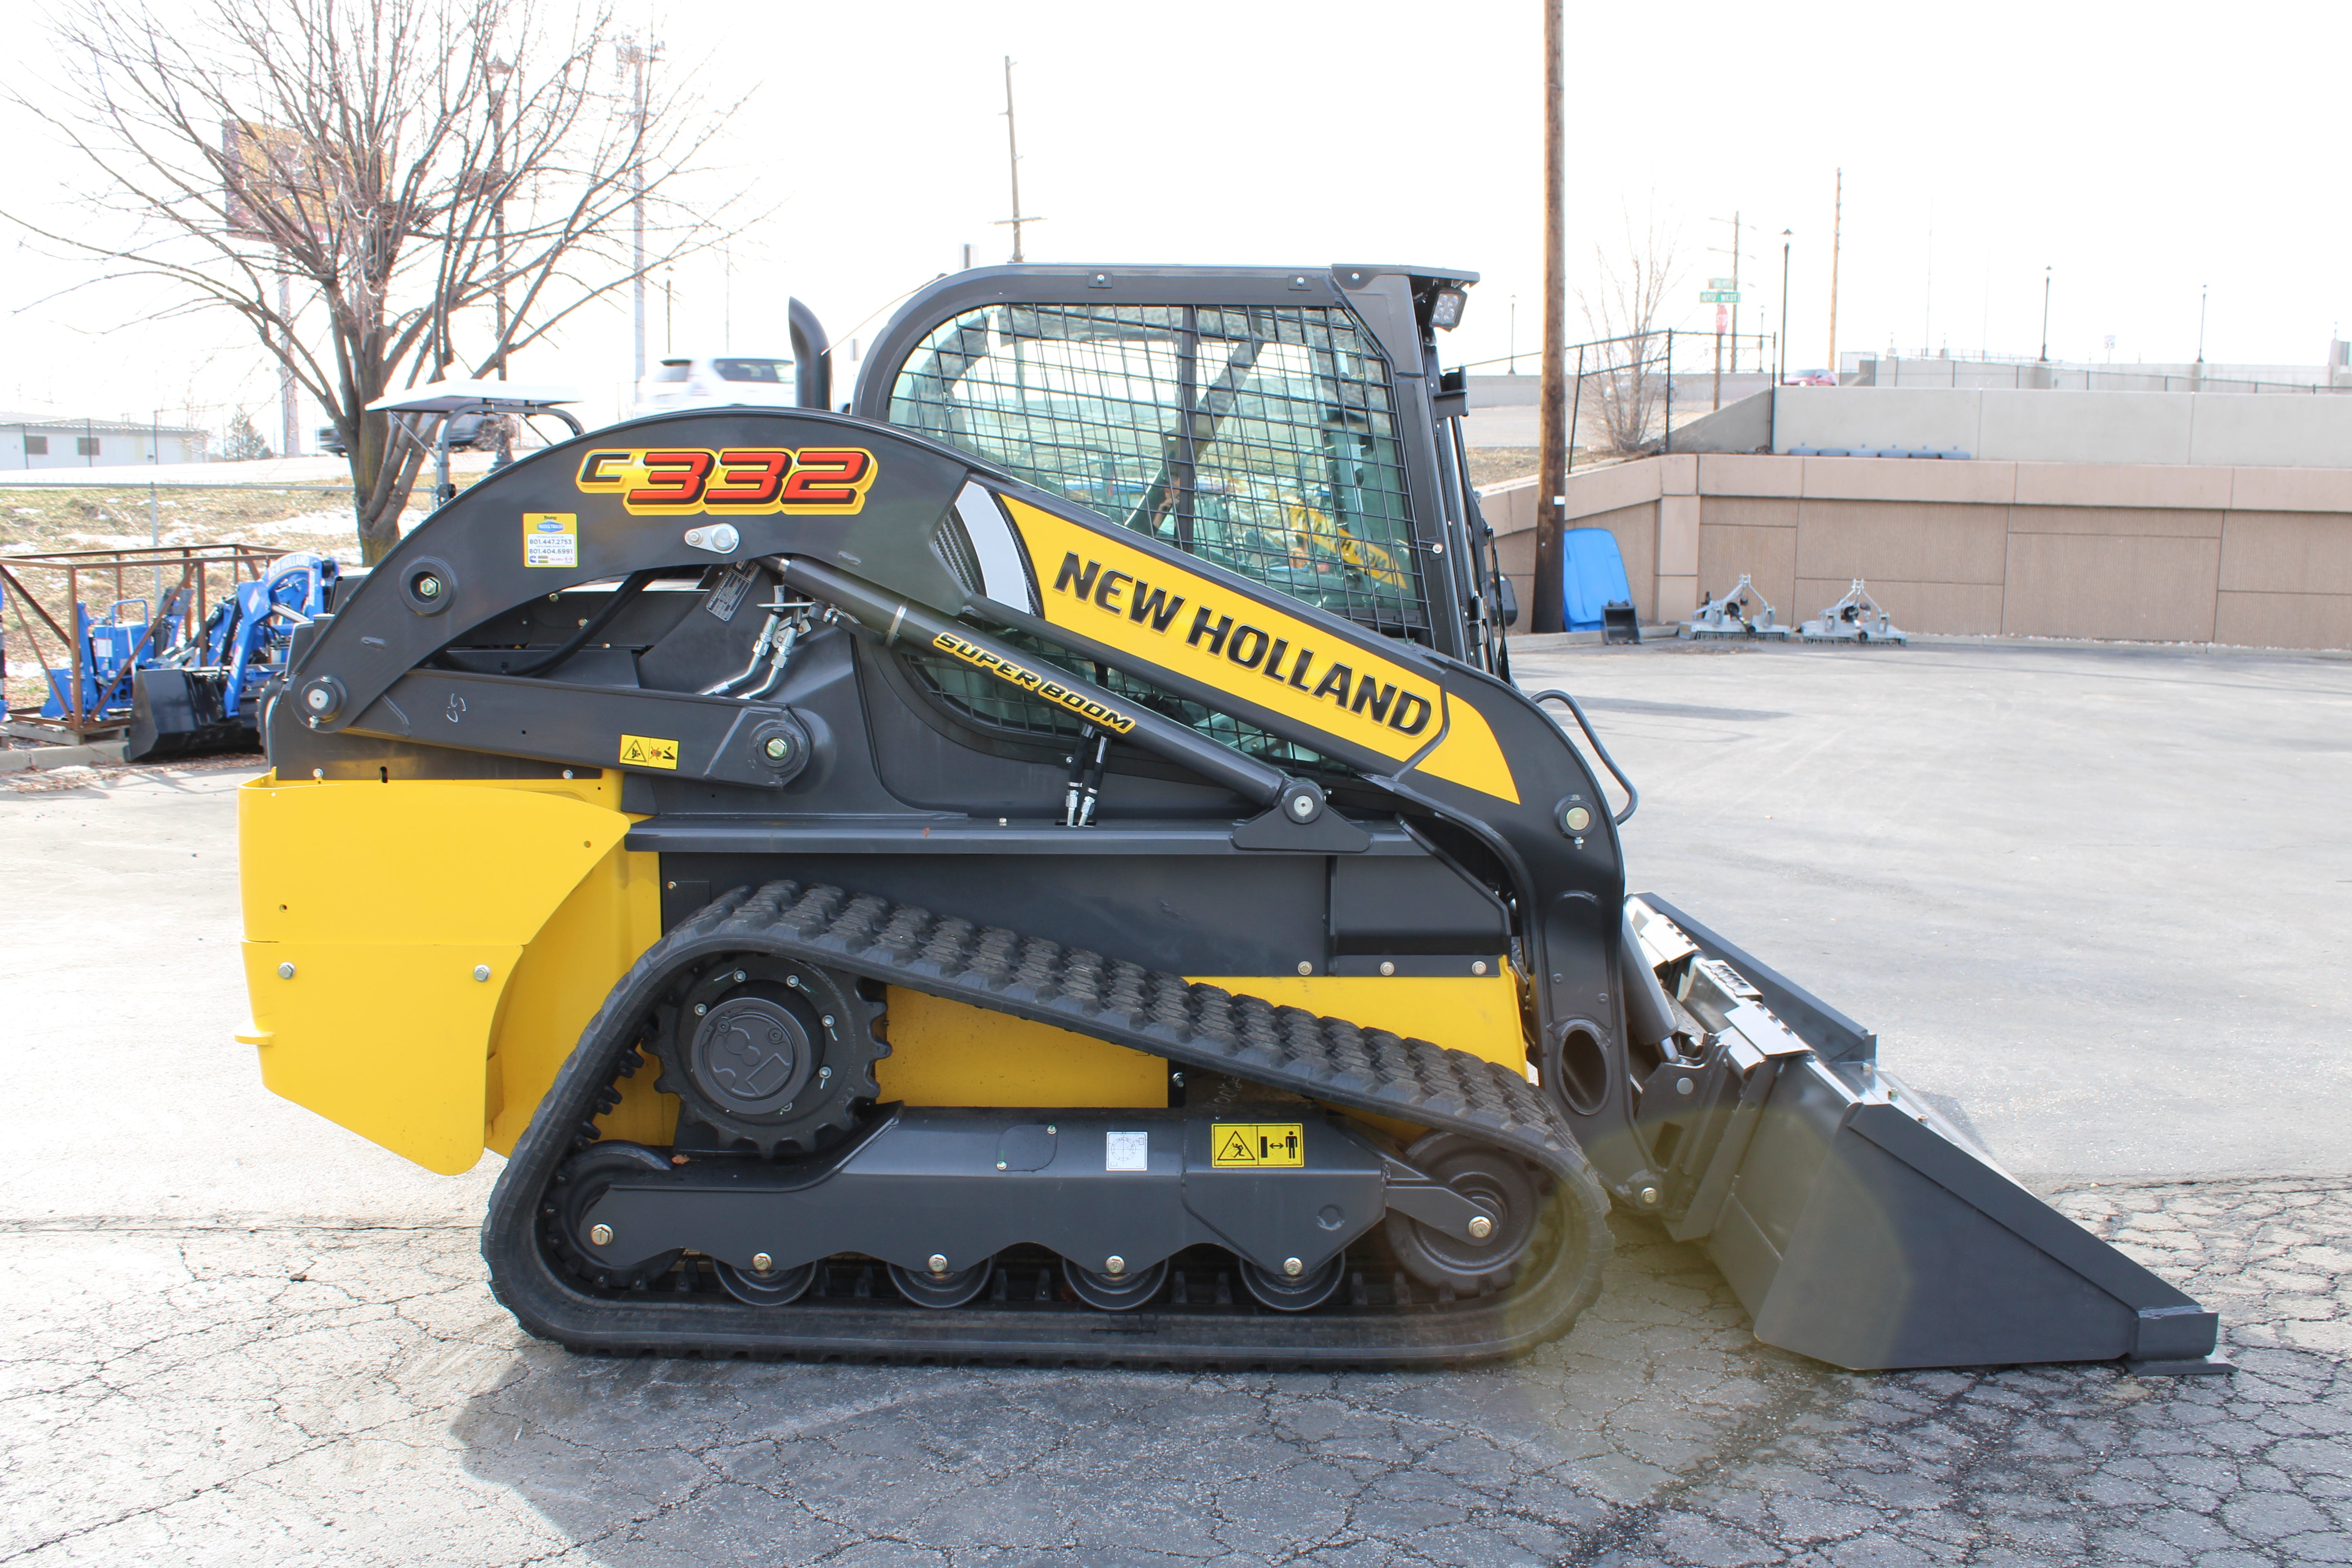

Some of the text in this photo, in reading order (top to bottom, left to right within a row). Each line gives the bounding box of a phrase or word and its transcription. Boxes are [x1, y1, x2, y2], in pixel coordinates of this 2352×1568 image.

[579, 450, 871, 506] C332
[281, 555, 310, 570] HOLLAND
[1053, 550, 1432, 736] NEW HOLLAND
[934, 633, 1135, 732] SUPER BOOM
